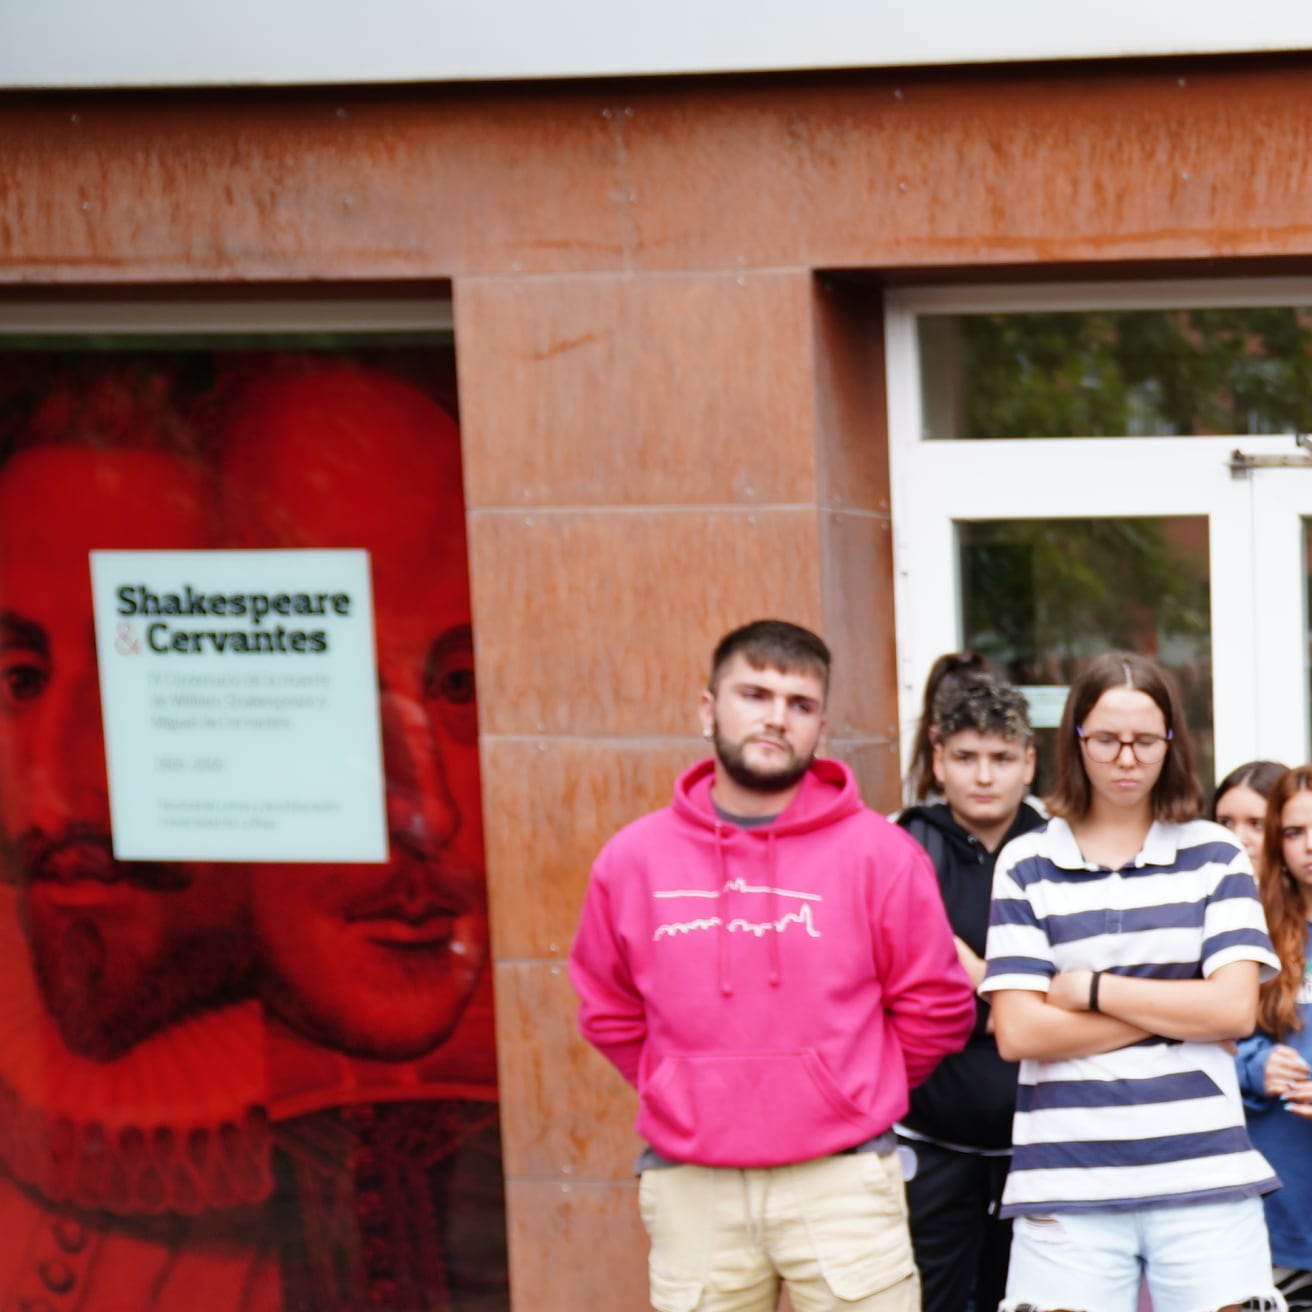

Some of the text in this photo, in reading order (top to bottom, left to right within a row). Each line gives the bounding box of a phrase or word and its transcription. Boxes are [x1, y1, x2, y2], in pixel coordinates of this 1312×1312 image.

[117, 585, 352, 624] Shakespeare
[115, 621, 329, 655] & Cervantes
